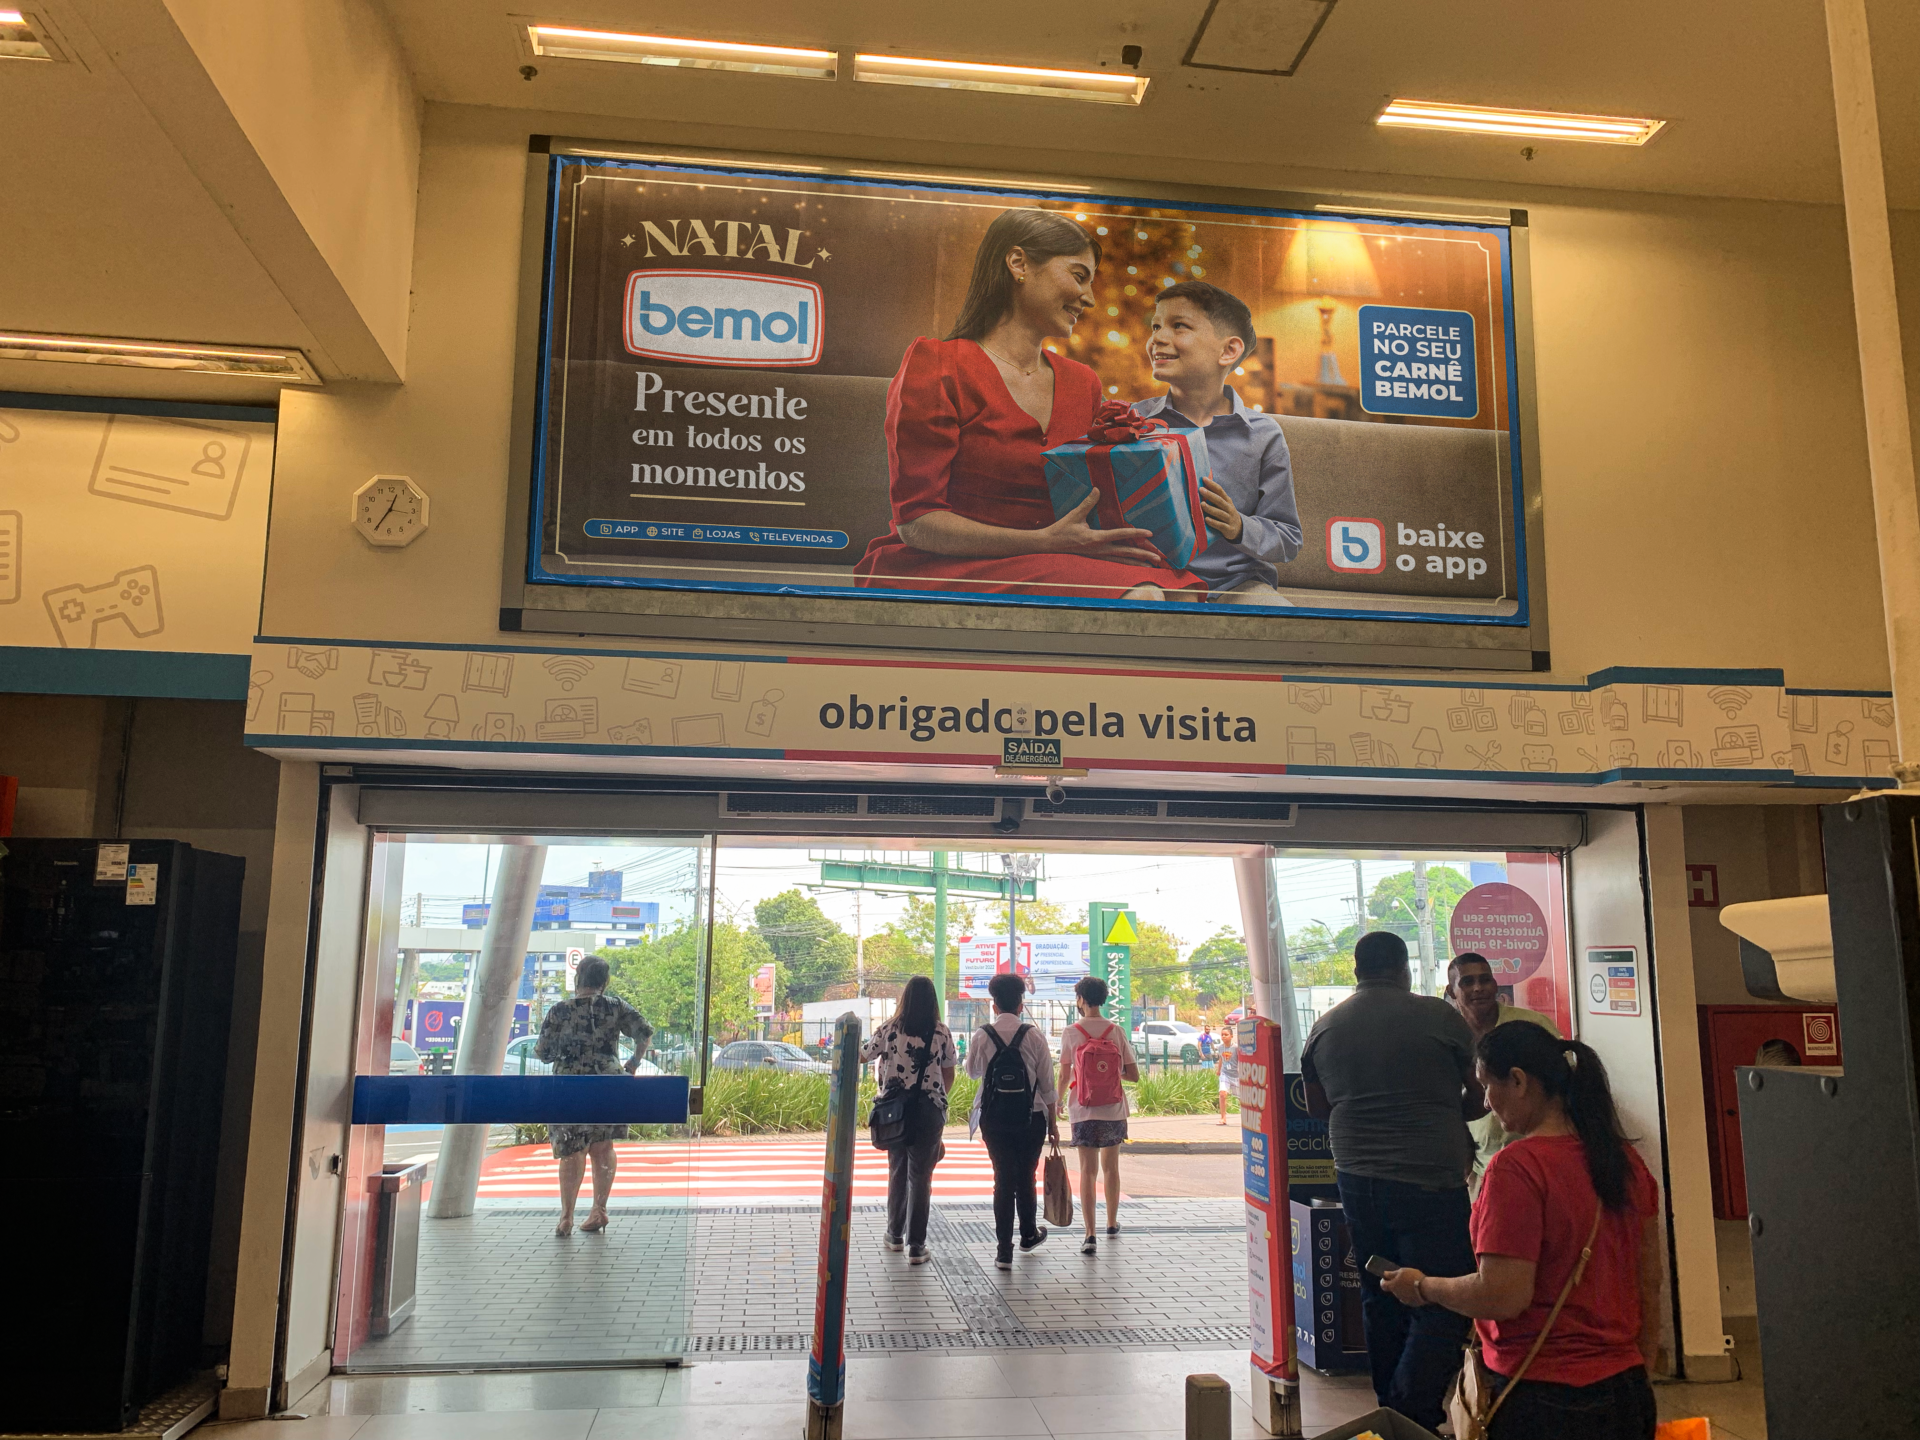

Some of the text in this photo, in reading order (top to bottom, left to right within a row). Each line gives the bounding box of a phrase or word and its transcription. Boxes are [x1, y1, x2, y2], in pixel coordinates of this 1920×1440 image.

[639, 219, 816, 269] NATAL
[639, 290, 809, 344] bemol
[1372, 321, 1461, 340] PARCELE
[1373, 338, 1462, 359] NO SEU
[1374, 360, 1463, 381] CARNÊ
[634, 371, 808, 420] Presente
[1375, 380, 1464, 401] BEMOL
[632, 425, 806, 454] em todos os
[630, 462, 806, 492] momentos
[615, 525, 833, 544] APP SITE LOJAS TELEVENDAS
[1397, 522, 1485, 549] baixe
[1395, 554, 1488, 581] o app
[818, 694, 1257, 743] obrigado pela visita
[1008, 740, 1057, 755] SAÍDA
[1015, 755, 1059, 763] EMERGÊNCIA
[1036, 942, 1070, 950] GRADUAÇÃO:
[572, 954, 579, 965] E
[1107, 952, 1120, 1025] MAZONAS
[1339, 1271, 1361, 1279] RESÍD
